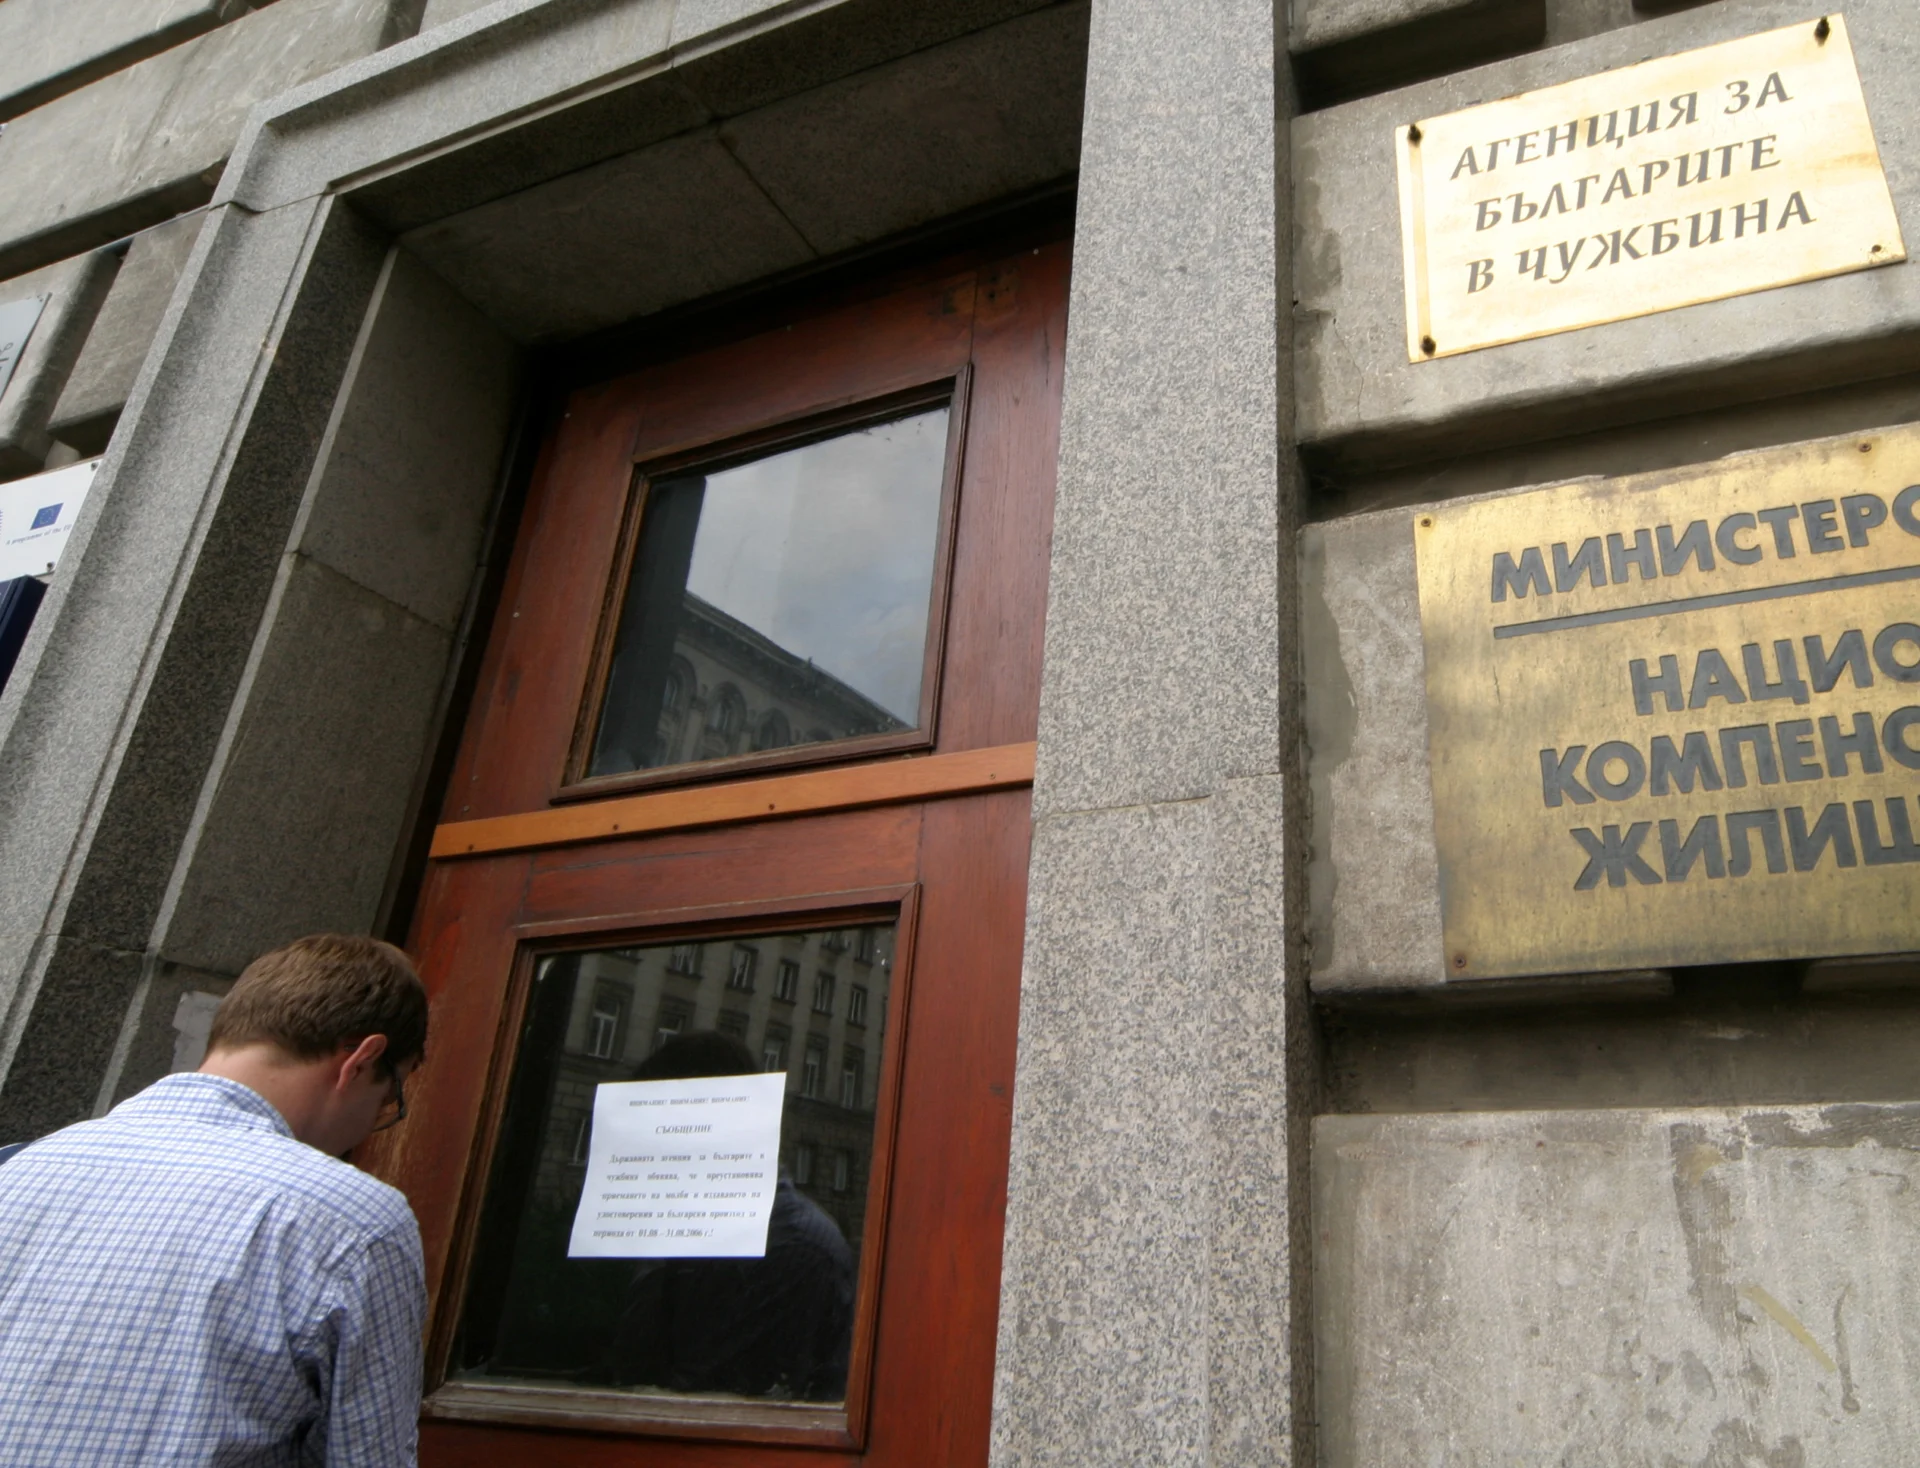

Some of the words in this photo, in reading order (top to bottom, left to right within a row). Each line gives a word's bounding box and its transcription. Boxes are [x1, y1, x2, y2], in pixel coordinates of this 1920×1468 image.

[1449, 91, 1698, 181] АГЕНЦИЯ
[1723, 71, 1793, 115] ЗА
[1474, 134, 1781, 232] БЪЛГАРИТЕ
[1465, 258, 1495, 295] В
[1514, 190, 1816, 284] ЧУЖБИНА
[1628, 622, 1920, 716] НАЦИО
[655, 1124, 713, 1135] СЪОБЩЕНИЕ
